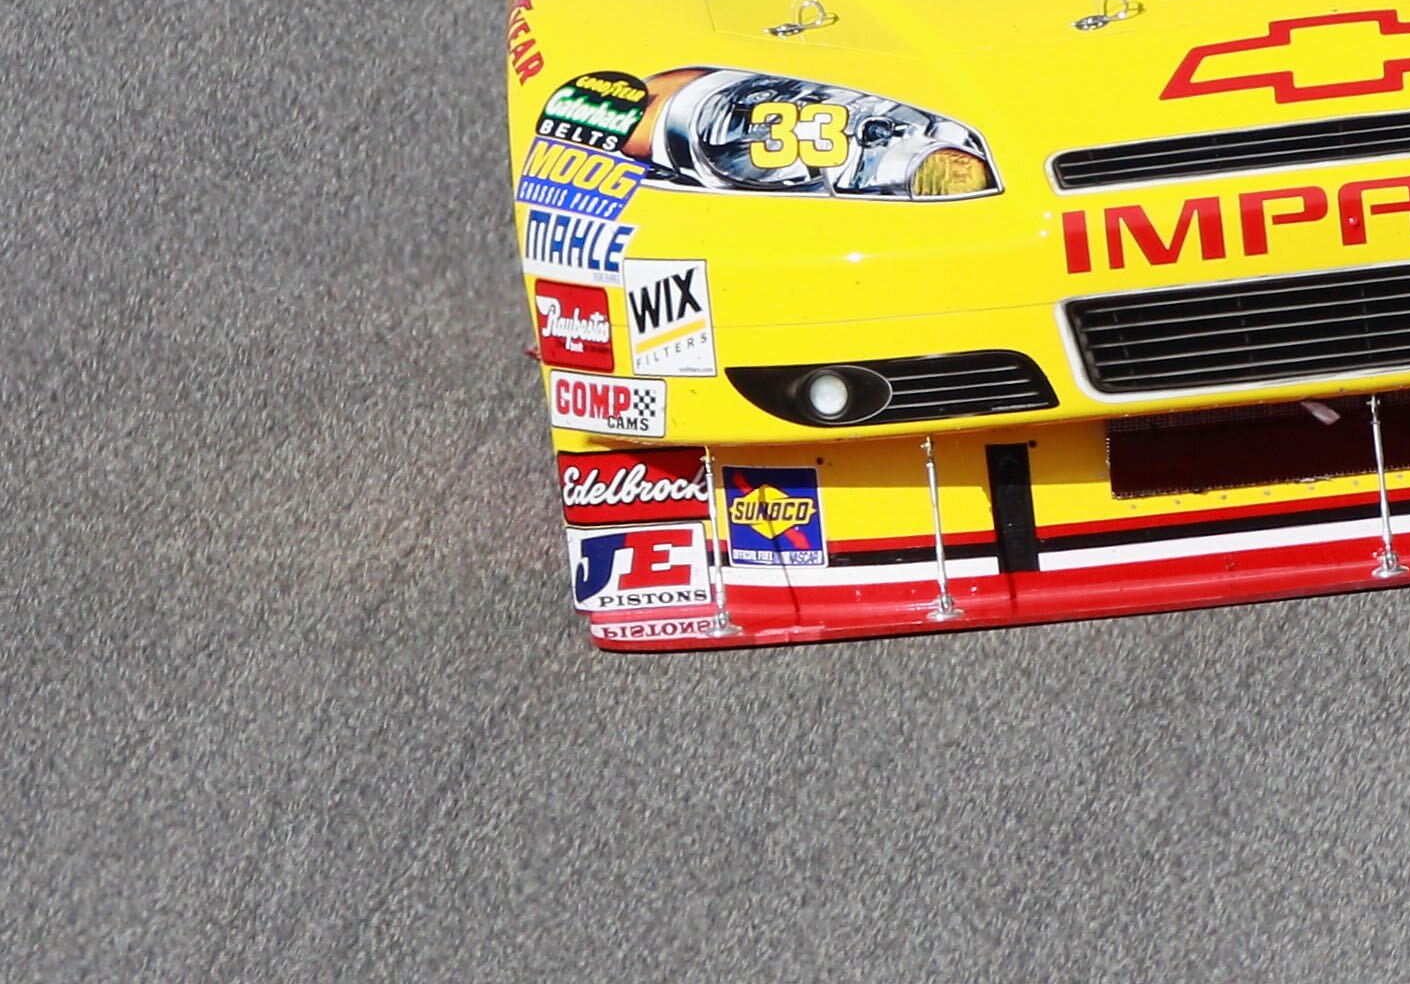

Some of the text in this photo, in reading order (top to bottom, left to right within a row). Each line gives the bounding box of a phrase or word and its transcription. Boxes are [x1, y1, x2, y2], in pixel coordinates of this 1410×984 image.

[545, 86, 640, 135] Gatorback
[539, 119, 619, 152] BELTS
[749, 102, 849, 168] 33
[523, 140, 646, 200] MOOG
[519, 181, 619, 218] CHASSIS PARTS
[525, 210, 635, 273] MAHLE
[628, 267, 703, 334] WIX
[636, 333, 708, 367] FILTERS
[556, 378, 631, 420] COMP
[607, 414, 649, 432] CAMS
[563, 463, 709, 506] Edelbrock
[734, 501, 809, 521] SUNOCO
[575, 529, 693, 603] JE
[599, 589, 707, 608] PISTONS
